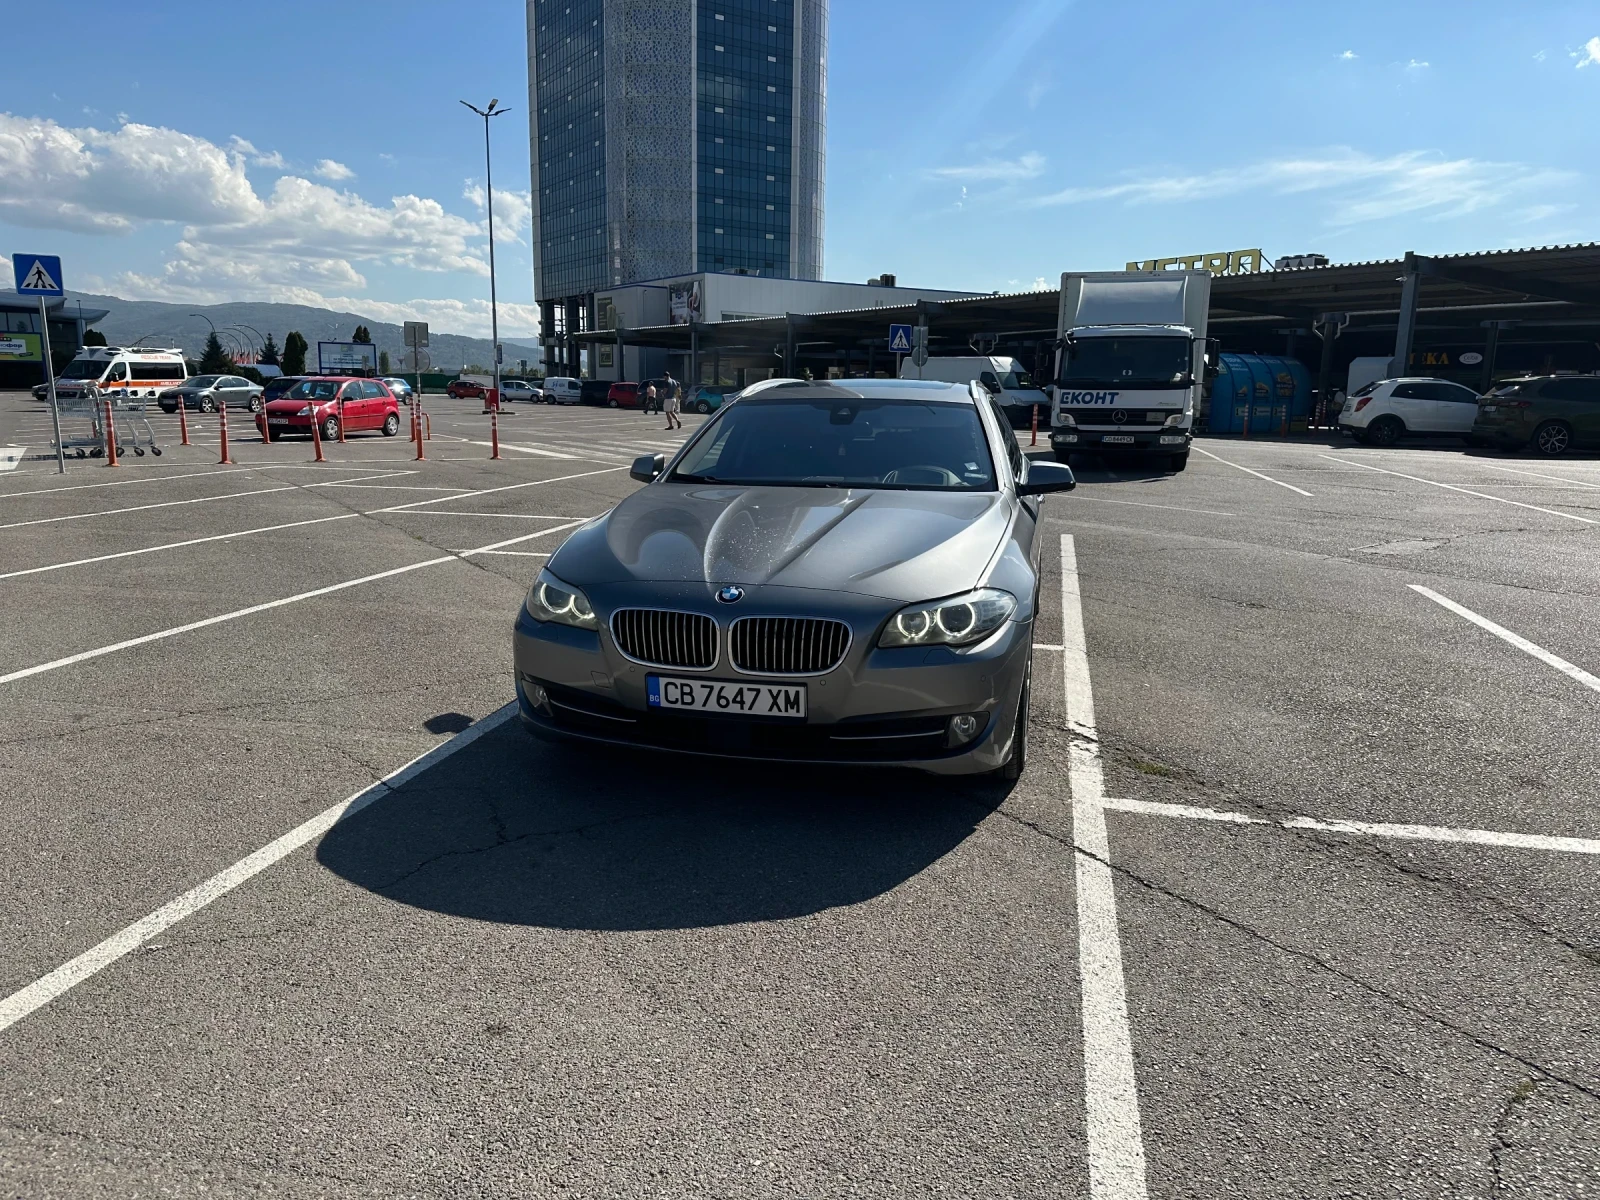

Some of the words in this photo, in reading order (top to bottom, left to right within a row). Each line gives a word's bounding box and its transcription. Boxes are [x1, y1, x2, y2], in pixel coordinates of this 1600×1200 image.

[1060, 391, 1120, 405] ЕКОНТ
[649, 694, 660, 703] BG
[664, 681, 696, 706] CB
[700, 684, 761, 711] 7647
[767, 688, 801, 714] XM
